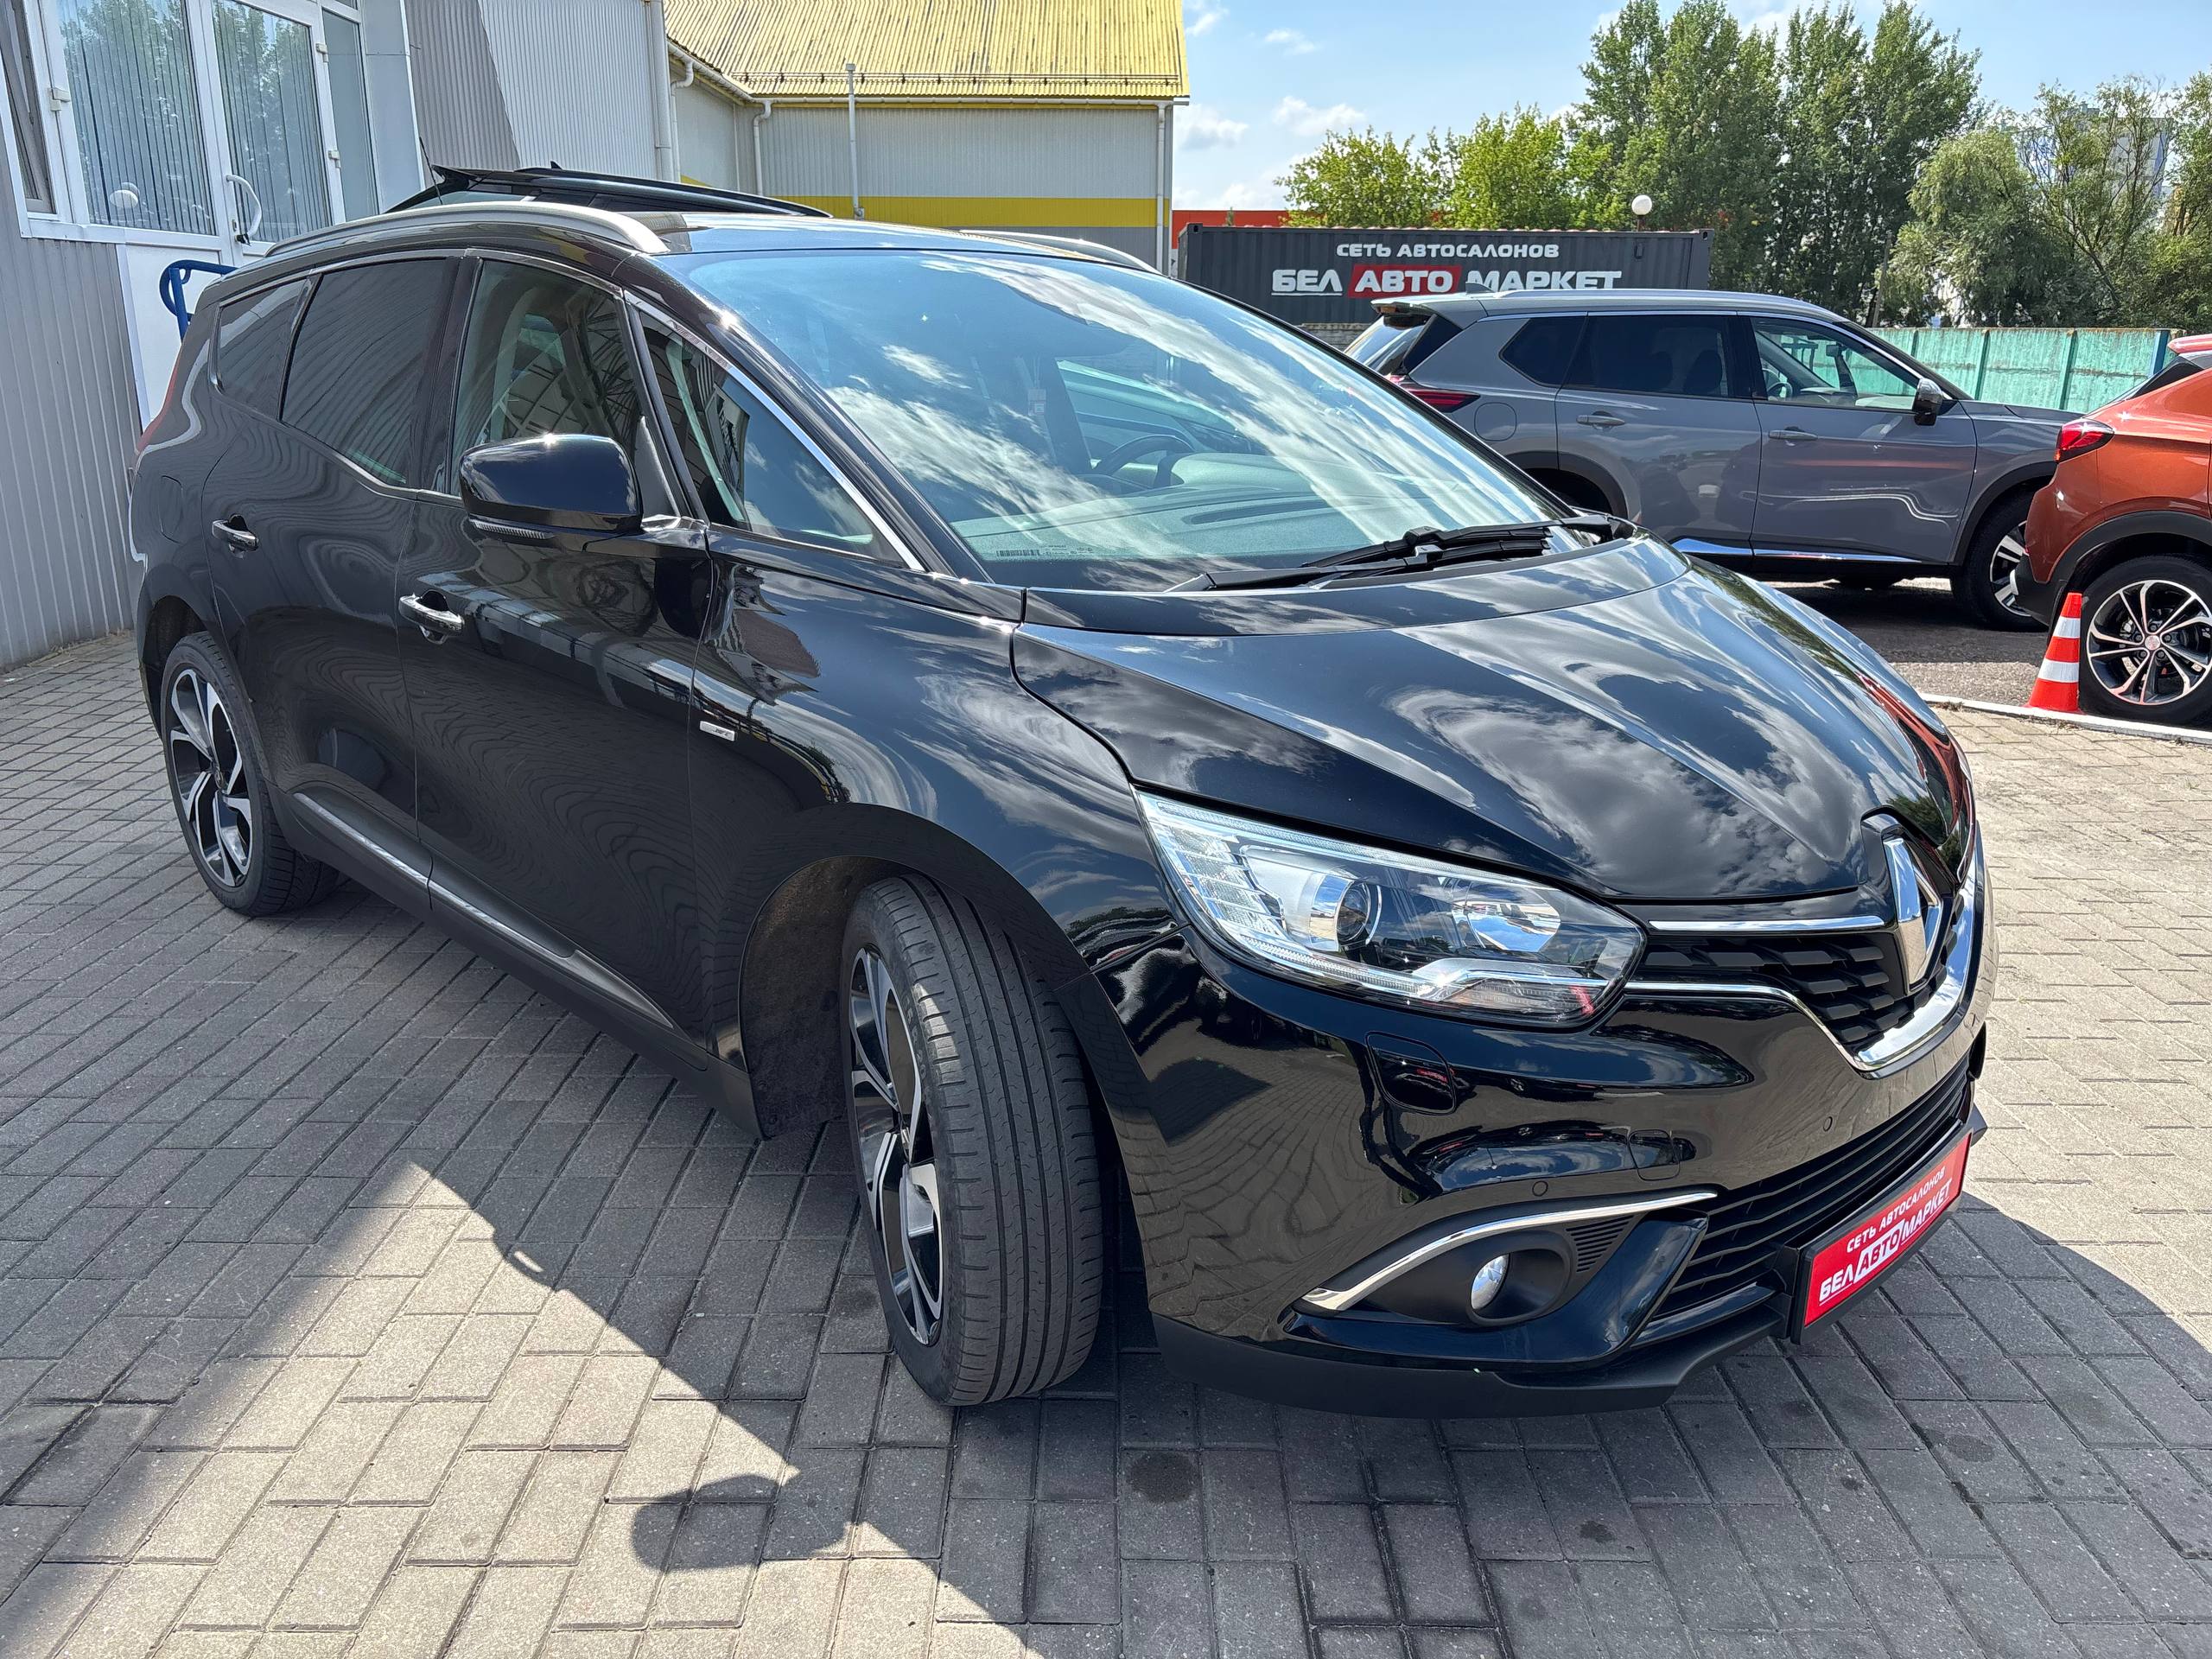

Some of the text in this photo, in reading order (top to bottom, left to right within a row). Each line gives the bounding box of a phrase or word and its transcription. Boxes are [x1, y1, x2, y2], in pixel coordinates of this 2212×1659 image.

[1337, 244, 1560, 258] СЕТЬ АВТОСАЛОНОВ
[1272, 269, 1622, 293] БЕЛ АВТО МАРКЕТ
[1847, 1166, 1946, 1253] СЕТЬ АВТОСАЛОНОВ
